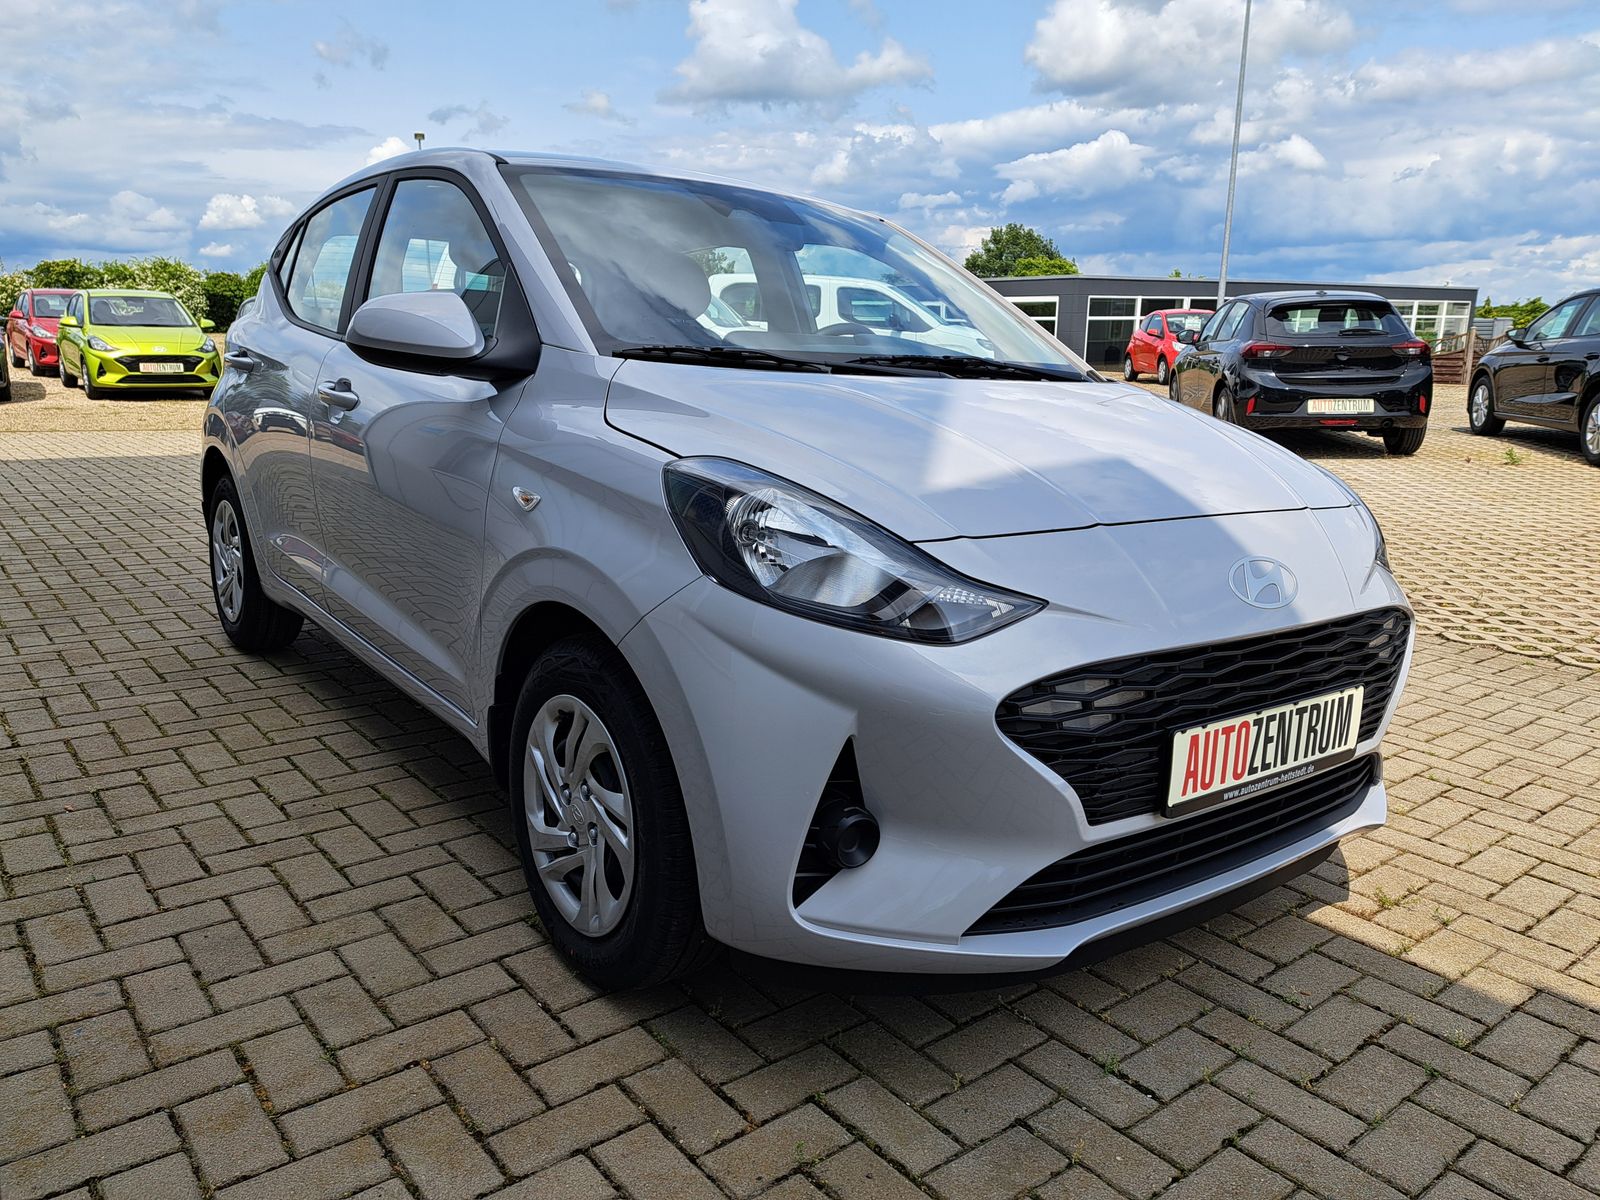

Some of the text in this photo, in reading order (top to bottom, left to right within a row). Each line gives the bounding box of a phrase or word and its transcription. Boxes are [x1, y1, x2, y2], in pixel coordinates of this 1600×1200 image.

[1312, 399, 1370, 411] AUTOZENTRUM
[1181, 693, 1354, 797] AUTOZENTRUM
[1223, 764, 1315, 800] www.autozentrum-hettstedt.de
